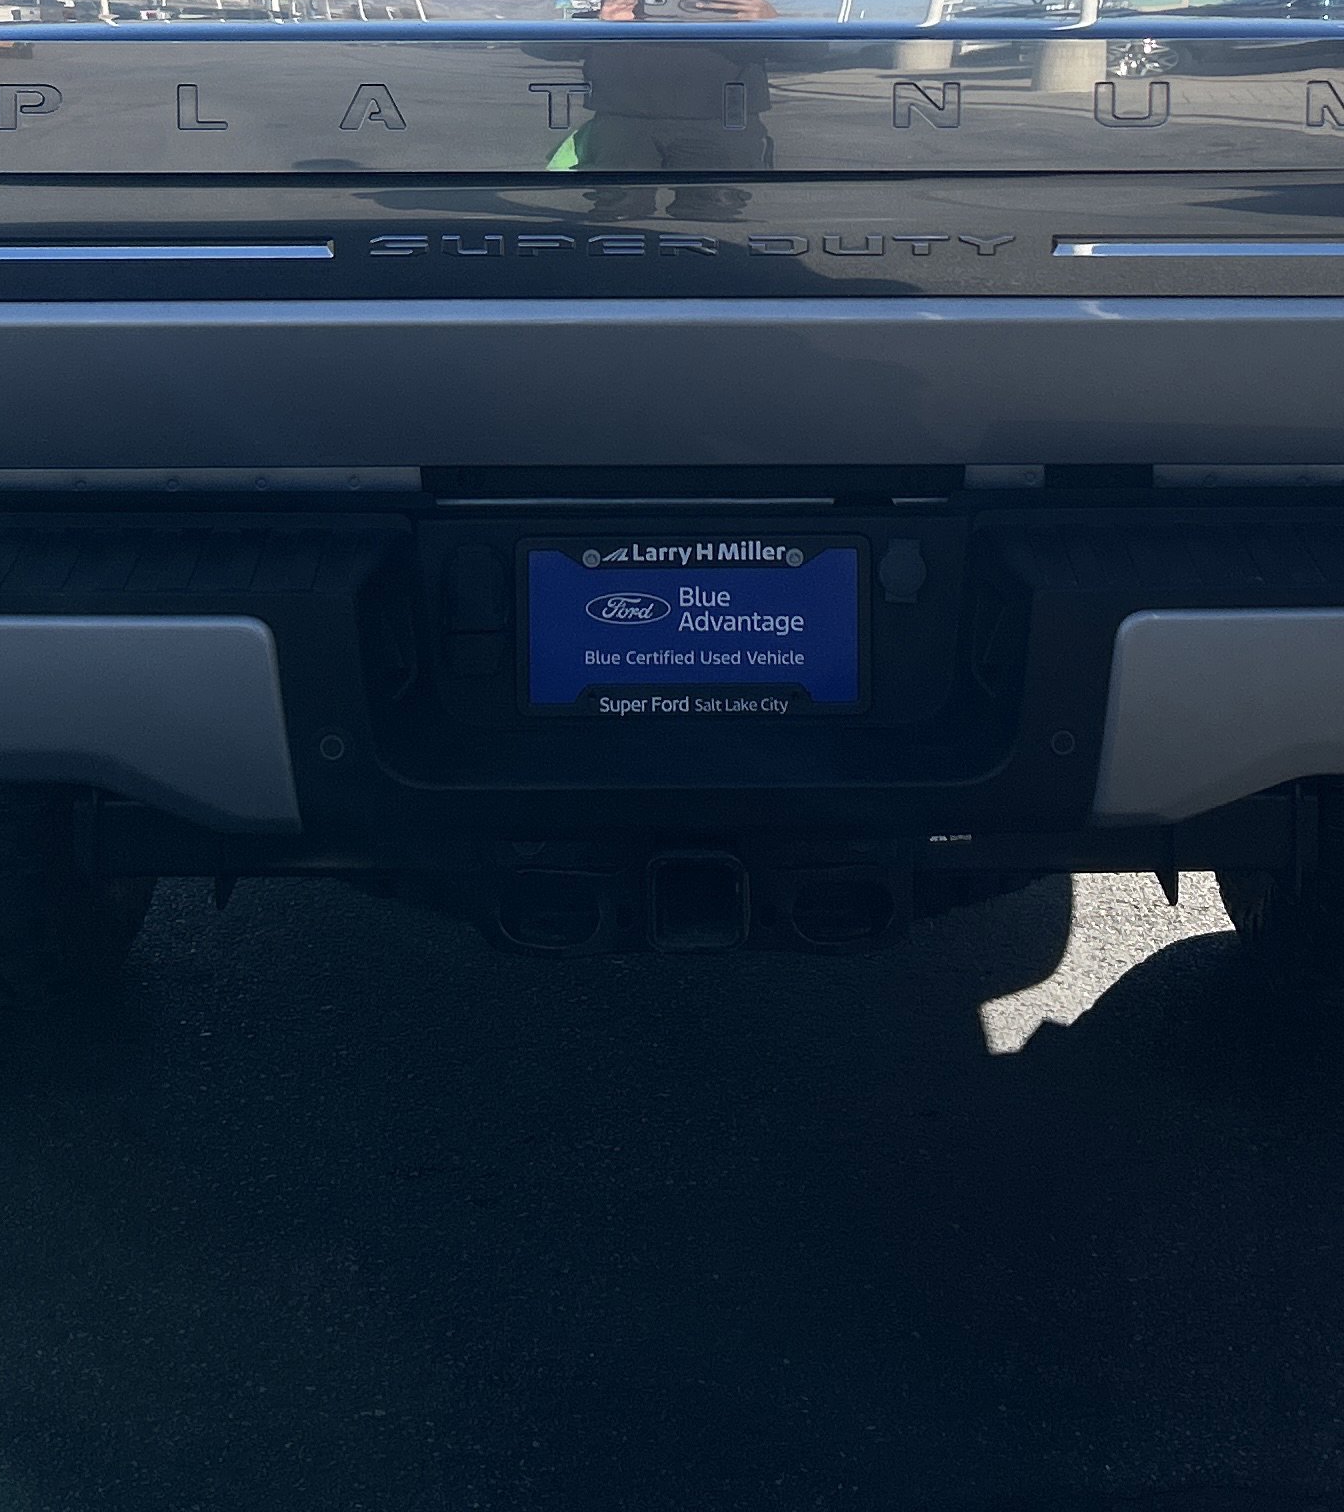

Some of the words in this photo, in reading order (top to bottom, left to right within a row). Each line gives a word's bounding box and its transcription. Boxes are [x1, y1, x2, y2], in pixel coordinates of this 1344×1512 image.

[369, 234, 719, 257] SUPER
[748, 234, 1016, 257] DUTY
[632, 544, 692, 565] Larry
[697, 543, 713, 560] H
[718, 541, 786, 560] Miller
[601, 596, 654, 620] Ford
[679, 586, 731, 607] Blue
[678, 611, 805, 636] Advantage
[585, 650, 621, 665] Blue
[626, 650, 695, 665] Certified
[700, 650, 741, 665] Used
[747, 650, 805, 665] Vehicle
[600, 697, 648, 716] Super
[651, 696, 689, 712] Ford
[695, 698, 722, 712] Salt
[725, 698, 757, 712] Lake
[761, 698, 789, 714] City
